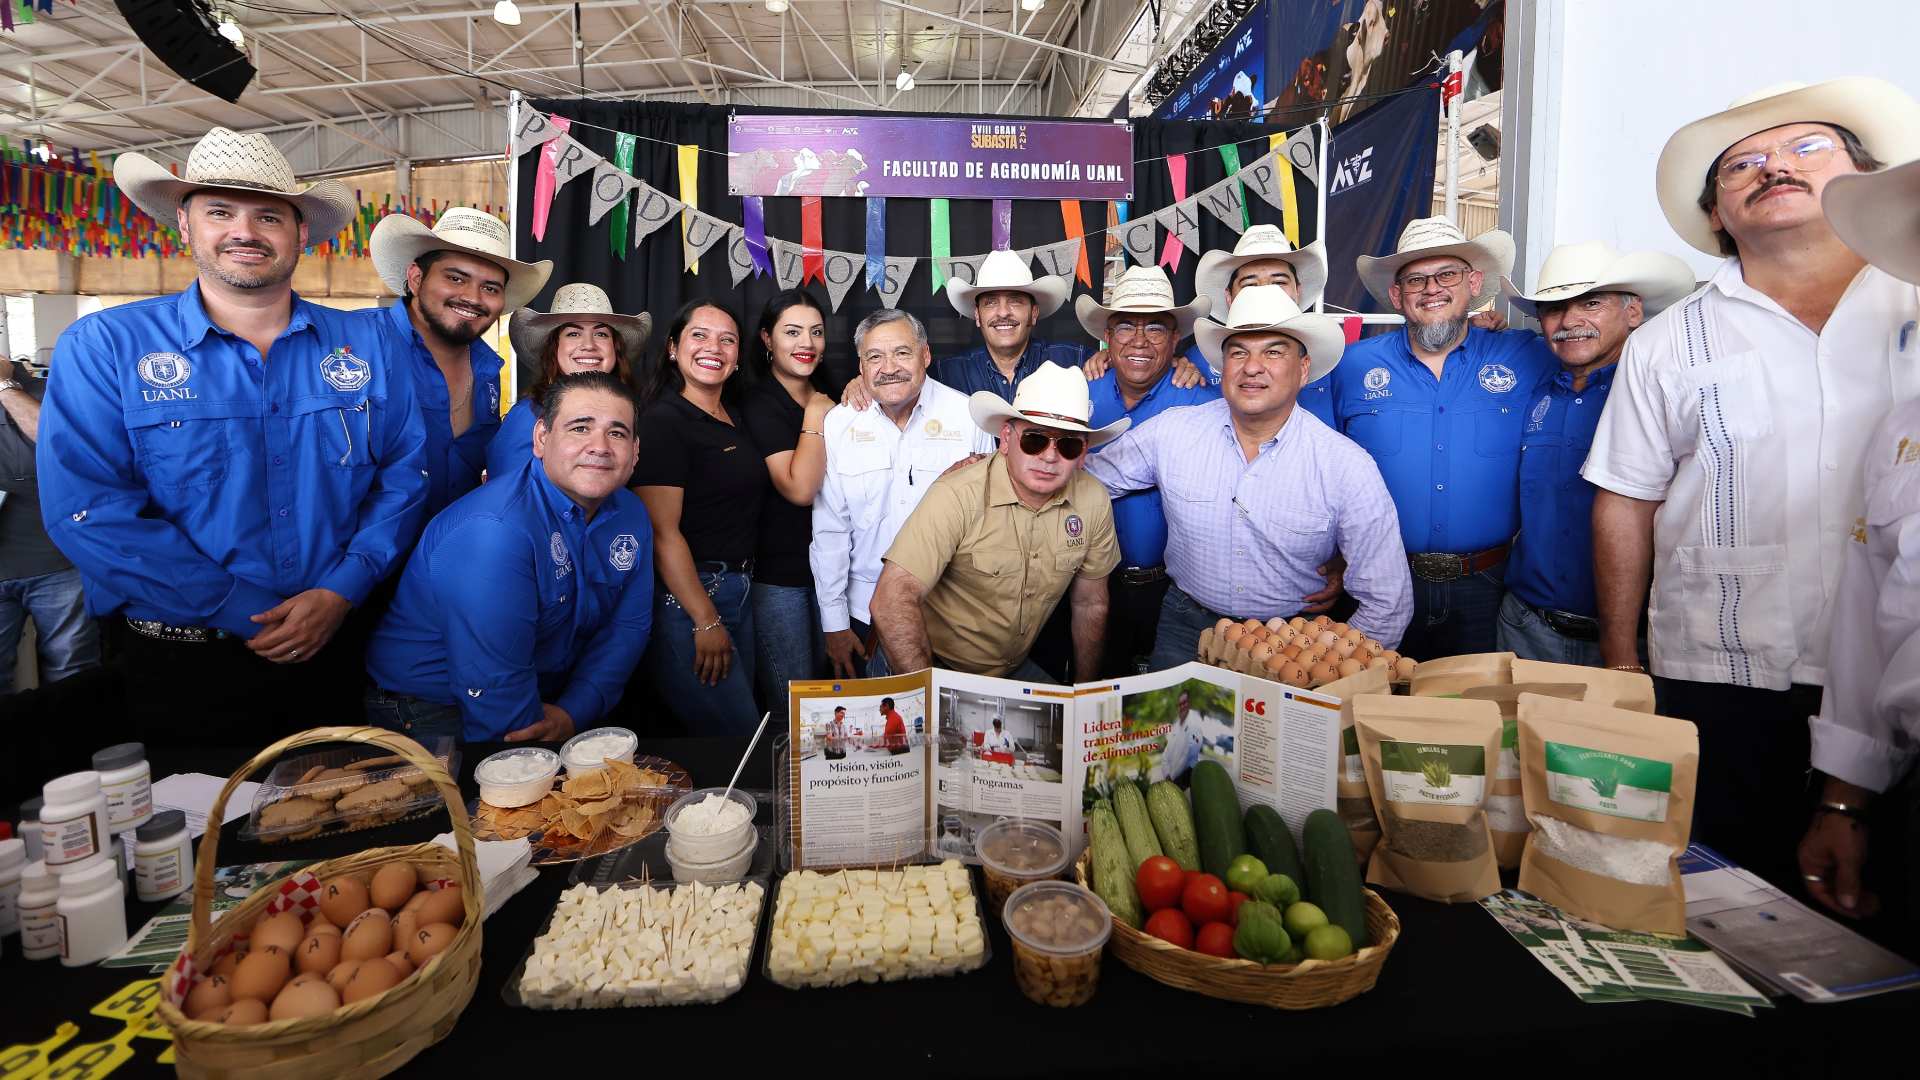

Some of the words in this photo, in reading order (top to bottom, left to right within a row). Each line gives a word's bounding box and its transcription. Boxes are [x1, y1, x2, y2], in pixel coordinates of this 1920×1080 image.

[971, 124, 992, 135] XVIII
[994, 125, 1016, 135] GRAN
[971, 134, 1018, 150] SUBASTA
[1019, 125, 1027, 150] UANL
[882, 160, 959, 178] FACULTAD
[965, 162, 984, 178] DE
[990, 160, 1081, 181] AGRONOMÍA
[1086, 164, 1124, 182] UANL
[949, 249, 1073, 287] DL
[1126, 141, 1313, 254] CAMPO
[141, 388, 198, 402] UANL
[1364, 390, 1393, 400] UANL
[1066, 538, 1084, 548] UANL
[1083, 720, 1121, 734] Lidera
[1083, 751, 1098, 762] de
[1099, 742, 1159, 760] alimentos
[829, 762, 868, 773] Misión,
[870, 758, 904, 770] visión,
[809, 776, 862, 789] propósito
[862, 777, 870, 786] y
[871, 768, 920, 784] funciones
[972, 775, 1024, 790] Programas
